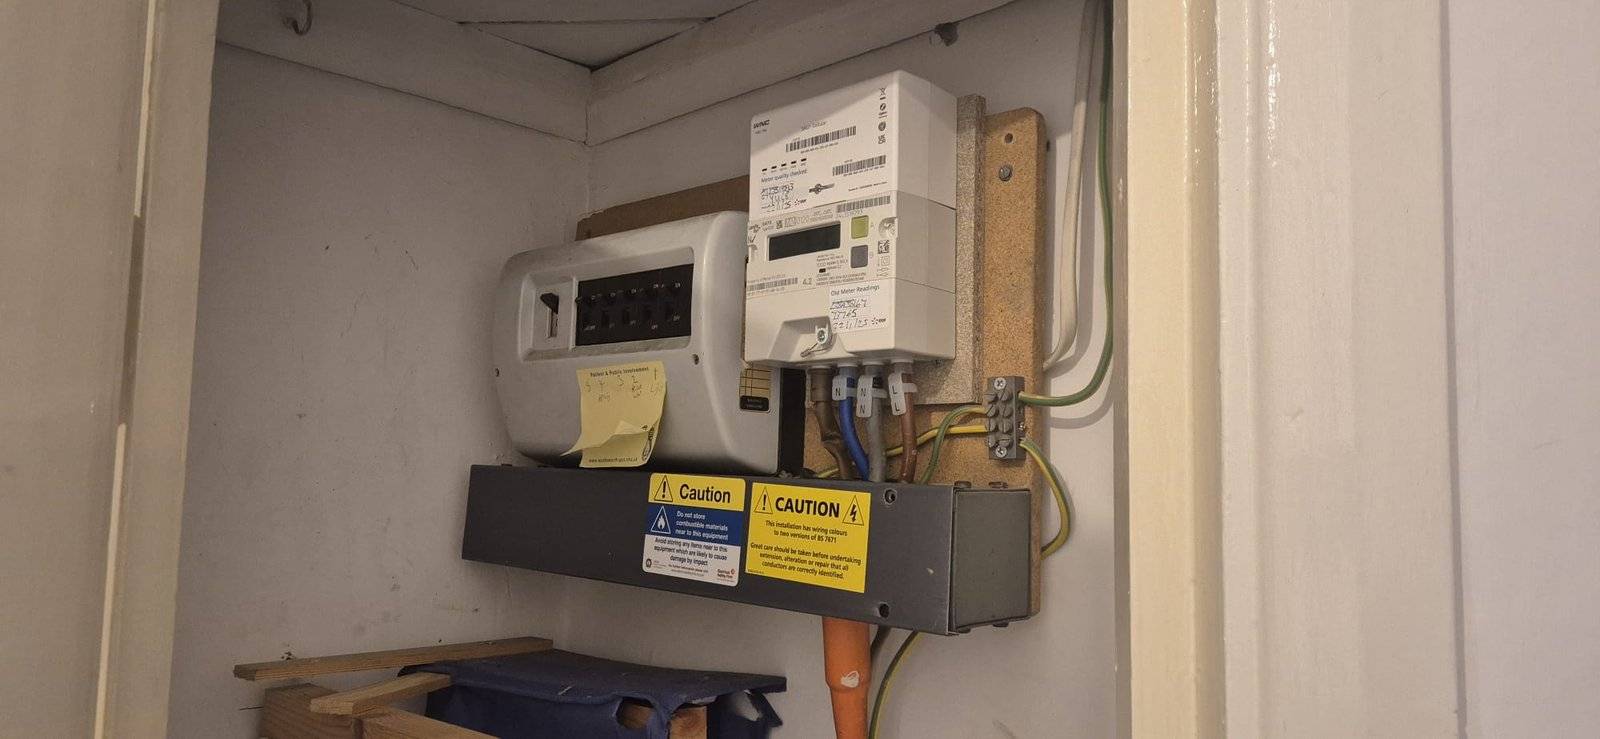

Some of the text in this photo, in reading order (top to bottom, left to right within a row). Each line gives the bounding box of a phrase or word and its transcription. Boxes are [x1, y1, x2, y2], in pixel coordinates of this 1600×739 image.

[774, 173, 789, 182] quality
[841, 287, 856, 295] Meter
[856, 284, 880, 293] Readings
[609, 369, 622, 377] Public
[622, 366, 649, 374] Involvement
[835, 387, 841, 396] N
[861, 387, 866, 396] N
[859, 404, 865, 413] N
[679, 483, 731, 503] Caution
[775, 496, 840, 518] CAUTION
[693, 512, 706, 520] store
[676, 519, 728, 532] combustible materials
[775, 521, 802, 530] installation
[812, 526, 828, 535] wiring
[829, 528, 848, 537] colours
[702, 531, 729, 541] equipment
[790, 532, 810, 541] versions
[810, 533, 817, 541] of
[824, 535, 837, 543] 7671
[667, 538, 681, 547] storing
[654, 545, 675, 553] equipment
[696, 550, 708, 559] likely
[750, 542, 763, 550] Great
[774, 546, 789, 554] should
[797, 549, 812, 557] taken
[812, 550, 829, 559] before
[829, 553, 862, 566] undertaking
[670, 555, 686, 564] damage
[759, 553, 783, 562] extension,
[784, 556, 808, 565] alteration
[815, 560, 830, 569] repair
[830, 562, 842, 570] that
[761, 561, 787, 570] conductors
[796, 566, 818, 576] correctly
[818, 570, 844, 580] identified.
